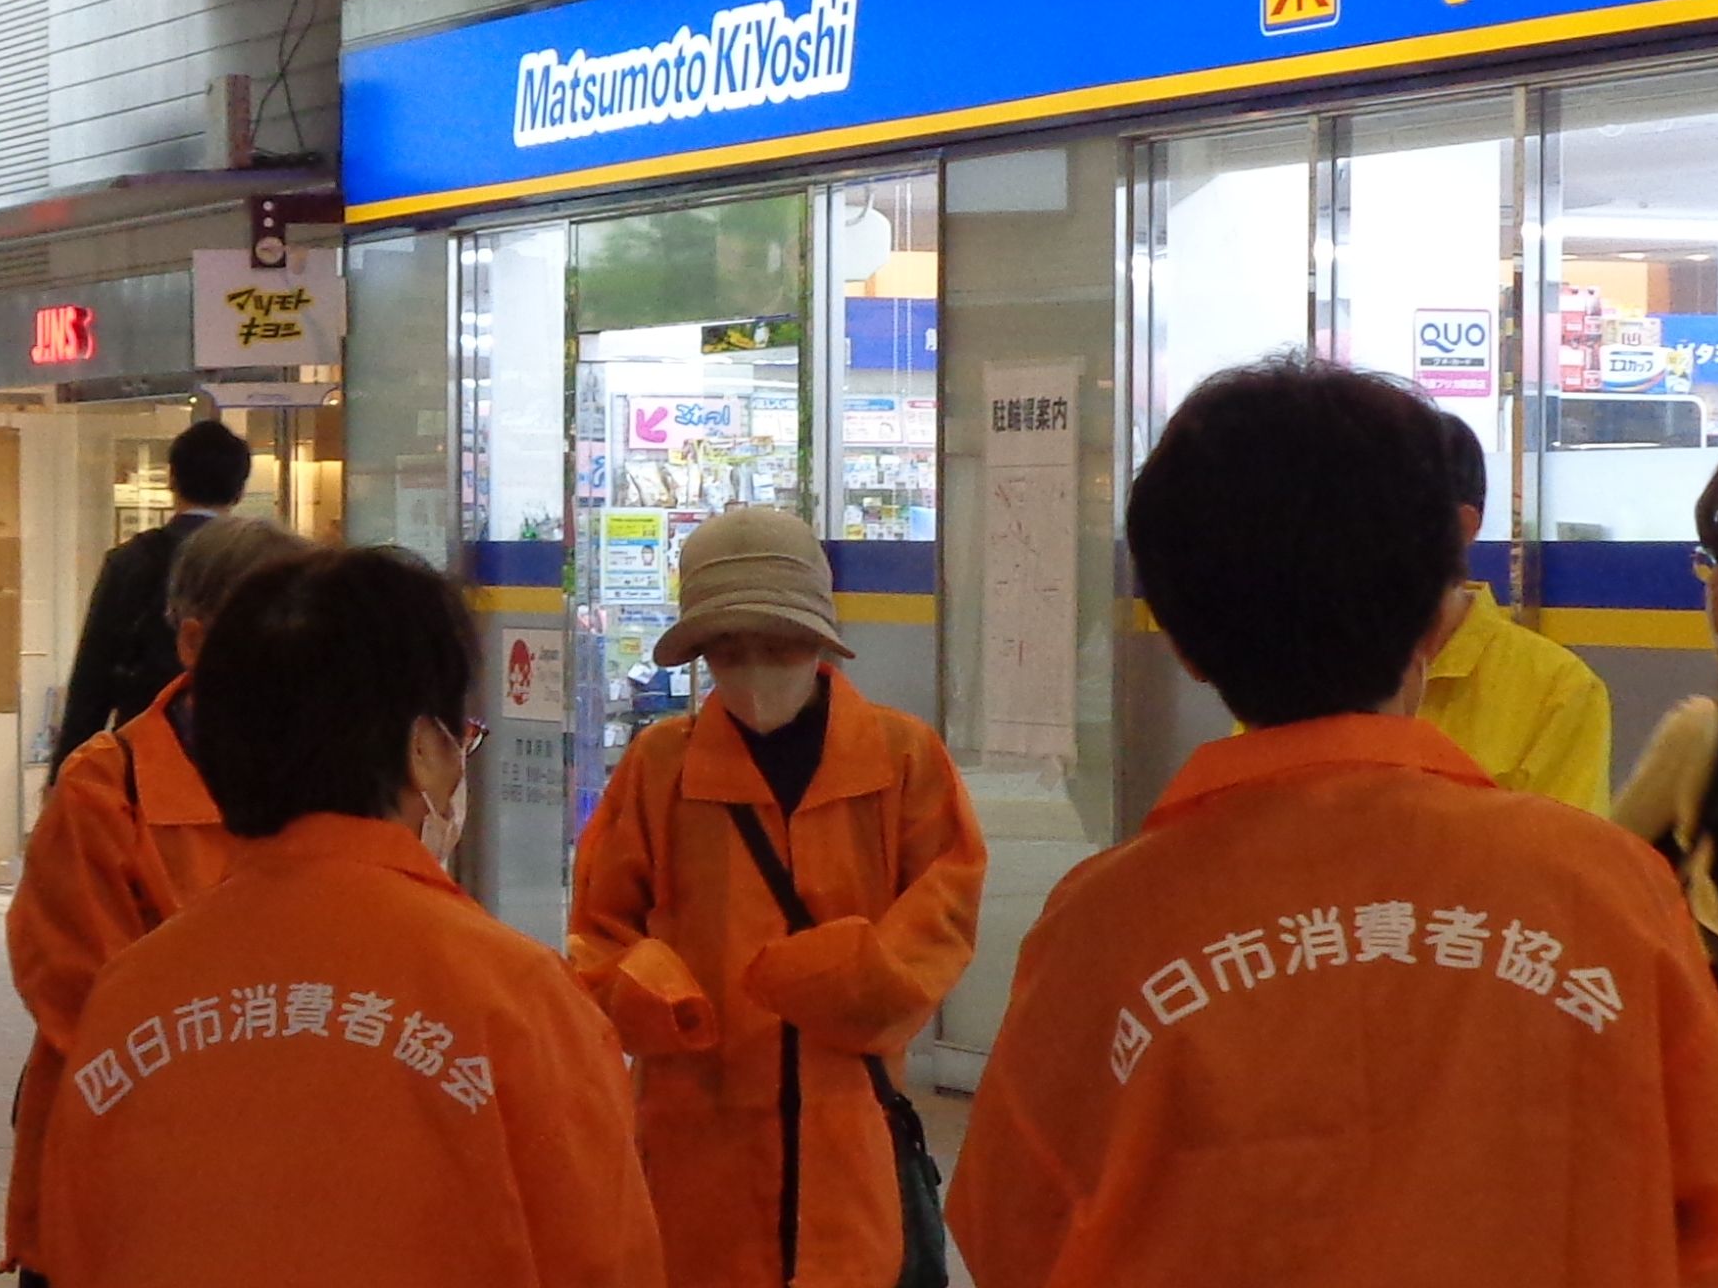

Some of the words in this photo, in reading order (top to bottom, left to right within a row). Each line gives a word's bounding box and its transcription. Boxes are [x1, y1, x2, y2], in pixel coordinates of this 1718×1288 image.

[520, 32, 706, 135] Matsumoto
[710, 0, 851, 87] KiYoshi
[224, 288, 312, 317] マツモト
[238, 318, 304, 345] キヨシ
[1419, 322, 1485, 354] QUO
[992, 396, 1067, 433] 駐輪場案内
[1110, 900, 1625, 1085] 四日市消費者協会
[73, 981, 496, 1116] 四日市消費者協会
